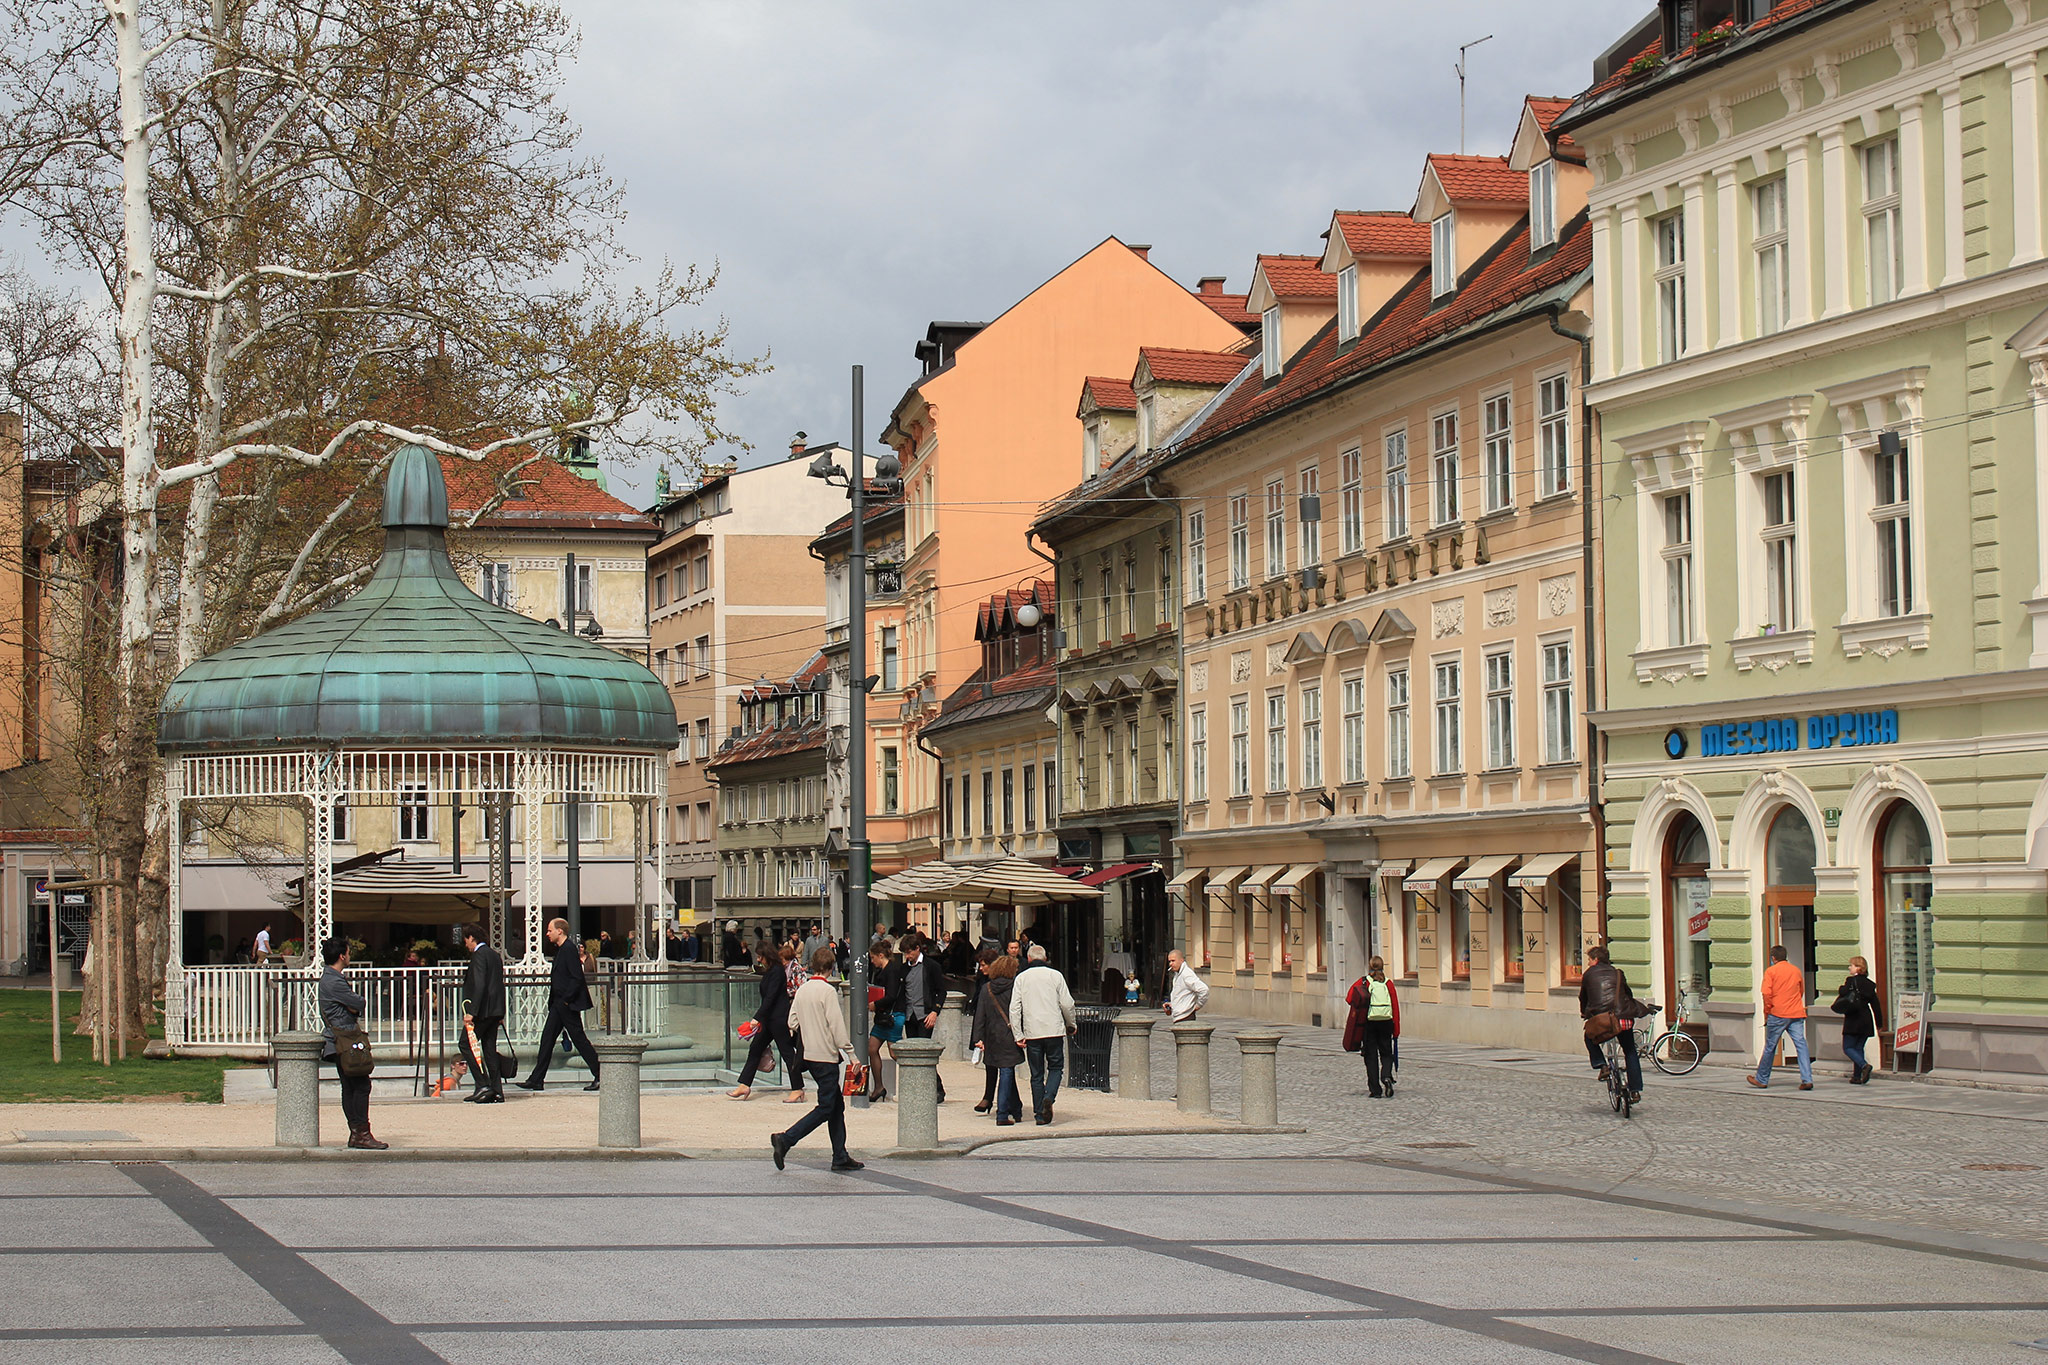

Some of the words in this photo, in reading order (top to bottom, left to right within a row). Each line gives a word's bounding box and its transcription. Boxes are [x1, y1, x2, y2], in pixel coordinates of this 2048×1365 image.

[1364, 527, 1491, 594] MATICA
[1807, 709, 1898, 749] OPTIKA
[1691, 919, 1701, 930] 125
[1897, 1030, 1909, 1043] 125
